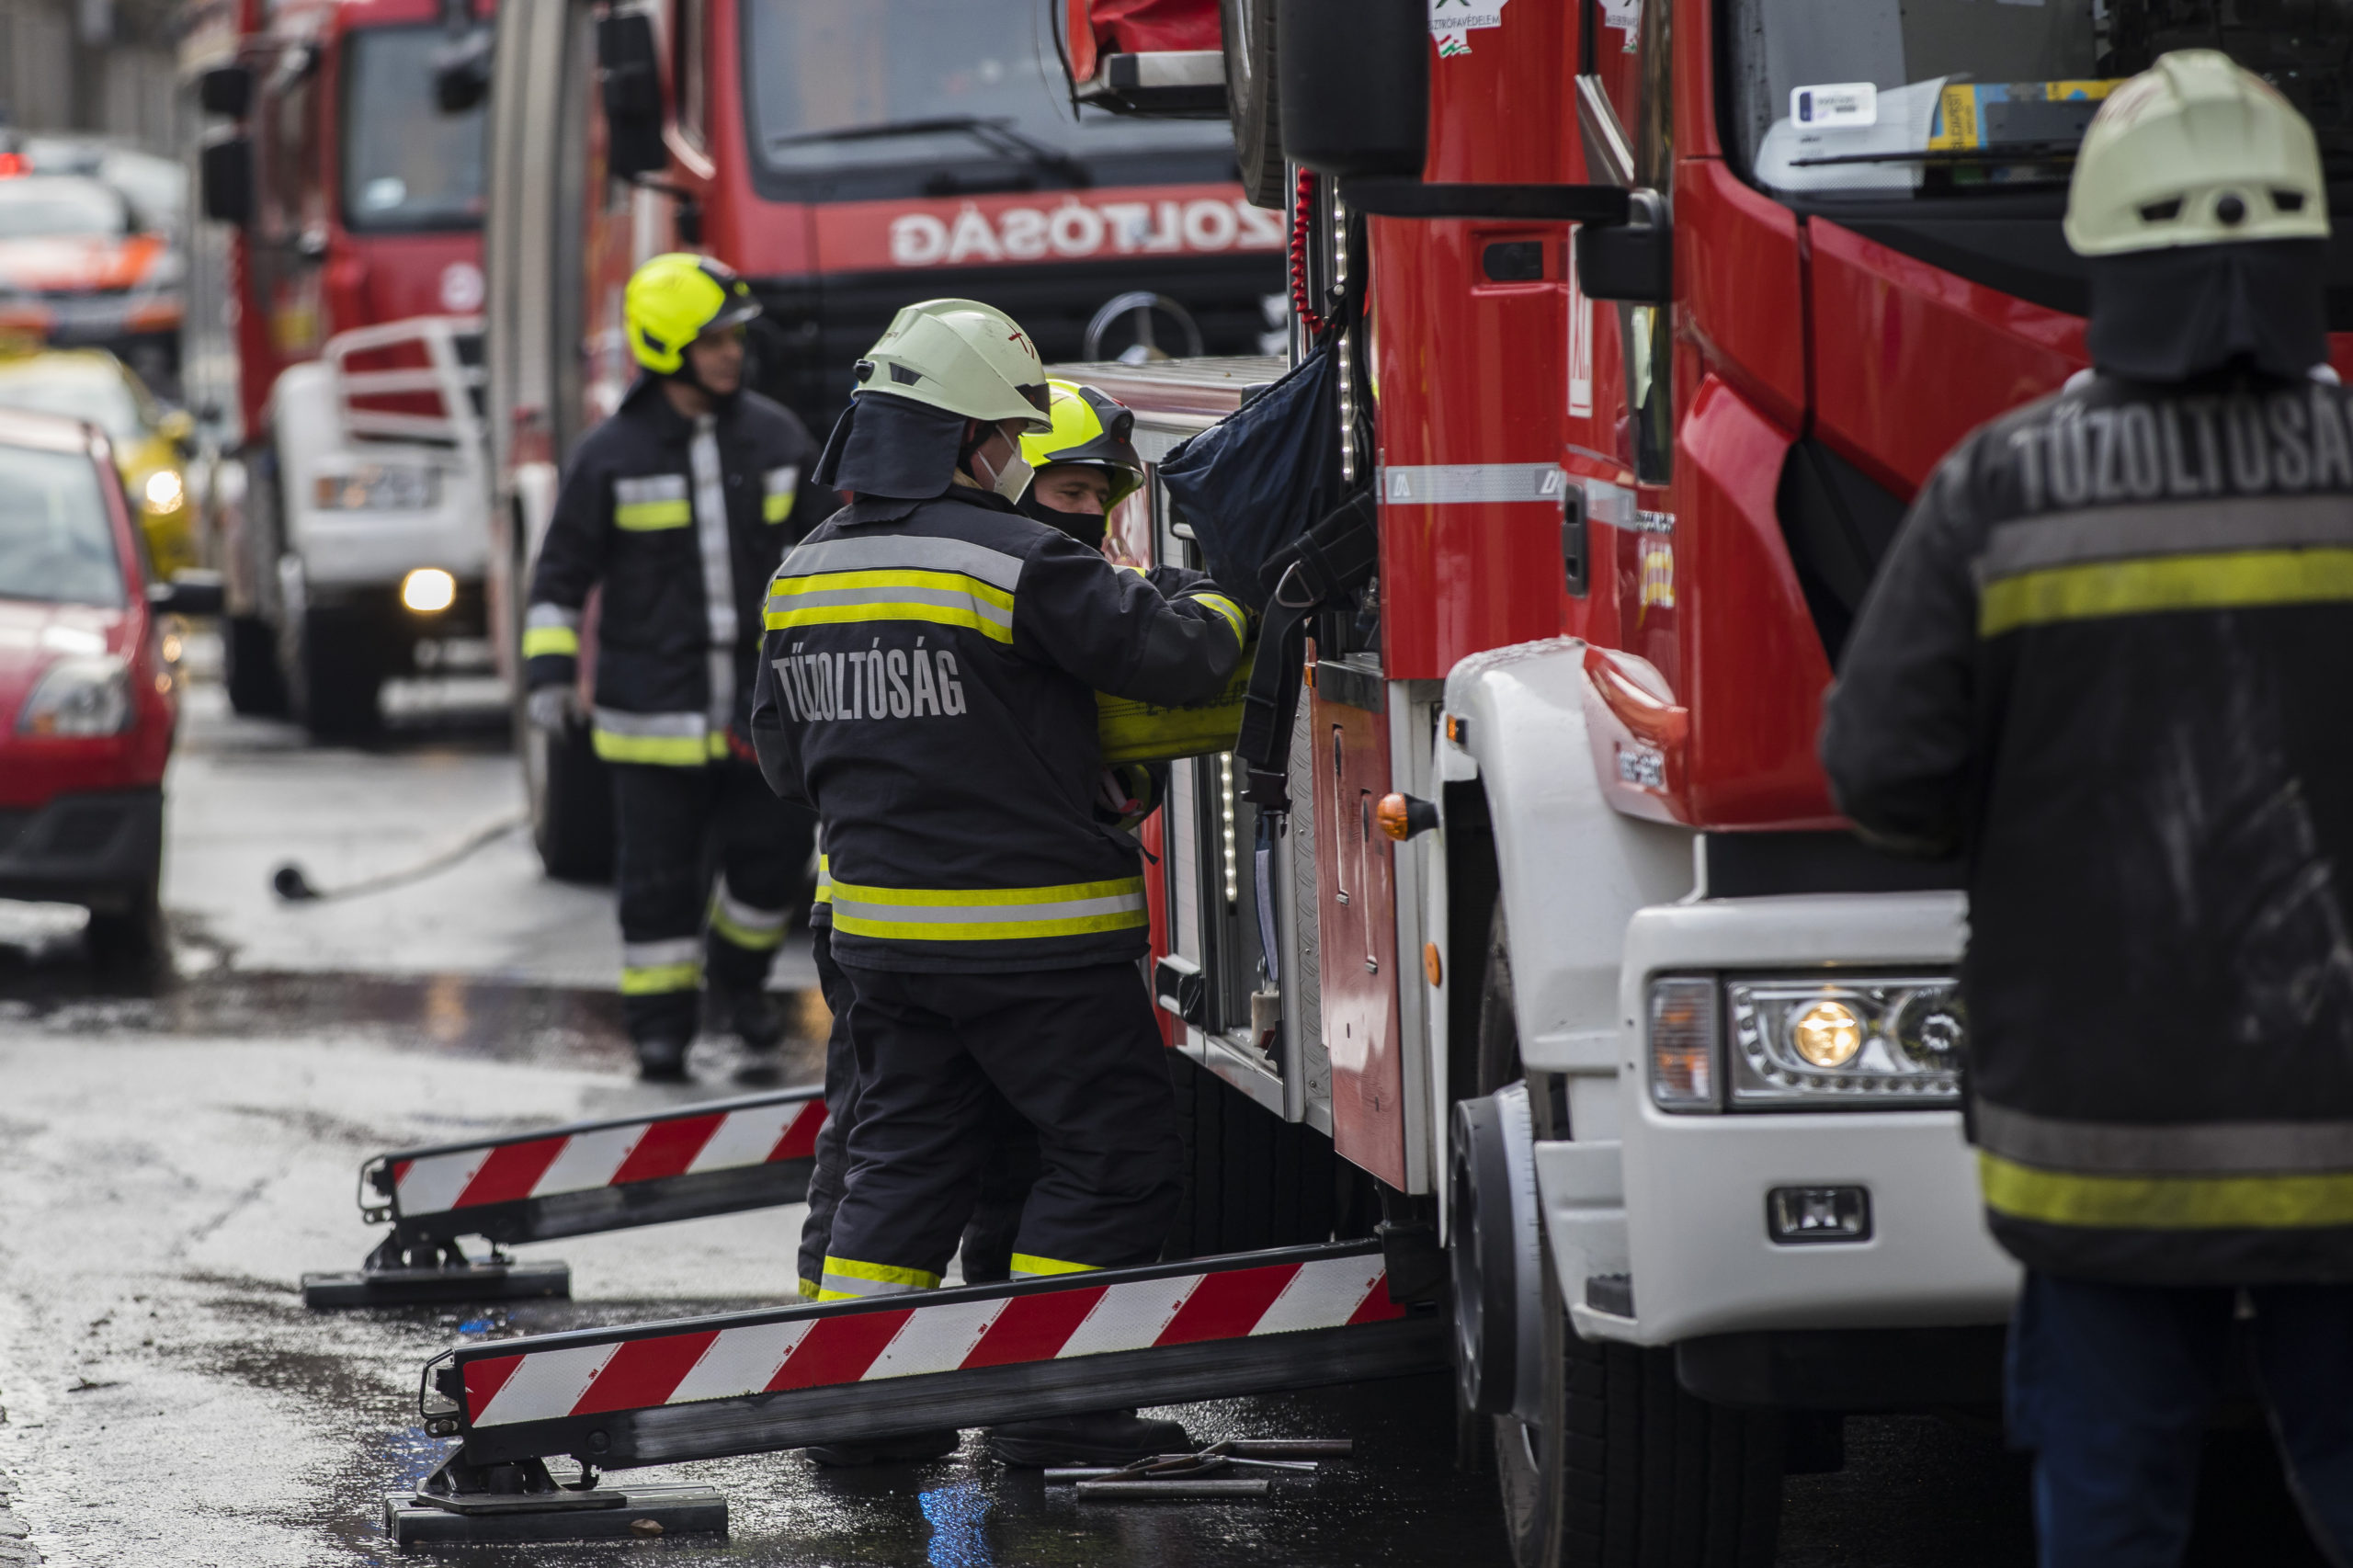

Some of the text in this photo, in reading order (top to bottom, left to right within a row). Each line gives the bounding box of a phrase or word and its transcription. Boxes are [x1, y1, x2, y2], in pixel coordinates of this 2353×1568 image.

[2008, 387, 2353, 509] TŰZOLTÓSÁ
[771, 636, 967, 722] TŰZOLTÓSÁG
[1172, 1300, 1182, 1312] 3M
[978, 1323, 988, 1335] 3M
[783, 1345, 794, 1357] 3M
[588, 1369, 599, 1381] 3M
